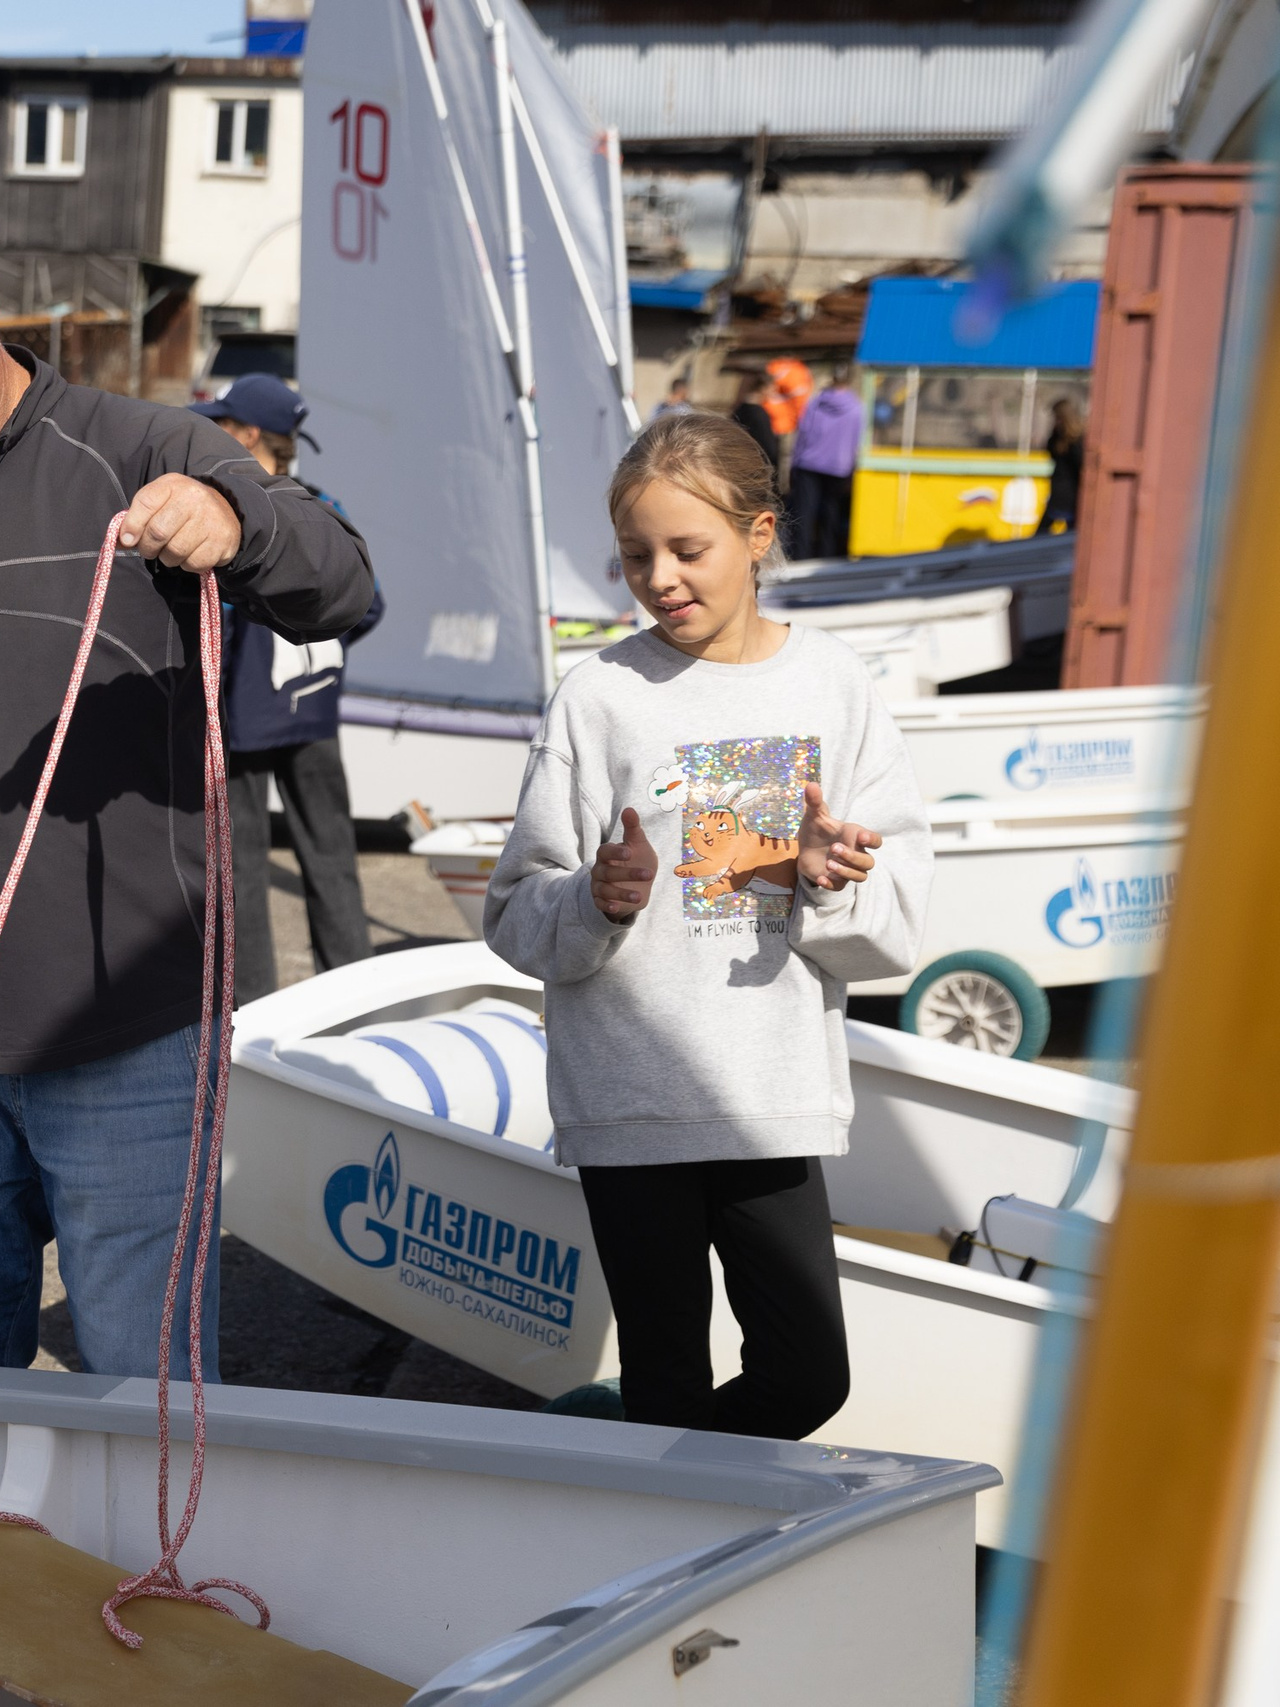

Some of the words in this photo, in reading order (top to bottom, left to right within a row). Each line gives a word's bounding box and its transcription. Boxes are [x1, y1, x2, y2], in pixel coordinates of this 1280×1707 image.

[330, 99, 390, 187] 10
[687, 924, 703, 938] I'M
[707, 922, 743, 936] FLYING
[748, 920, 761, 934] TO
[404, 1184, 581, 1295] ГАЗПРОМ
[399, 1266, 570, 1351] ЮЖНО-САХАЛИНСК
